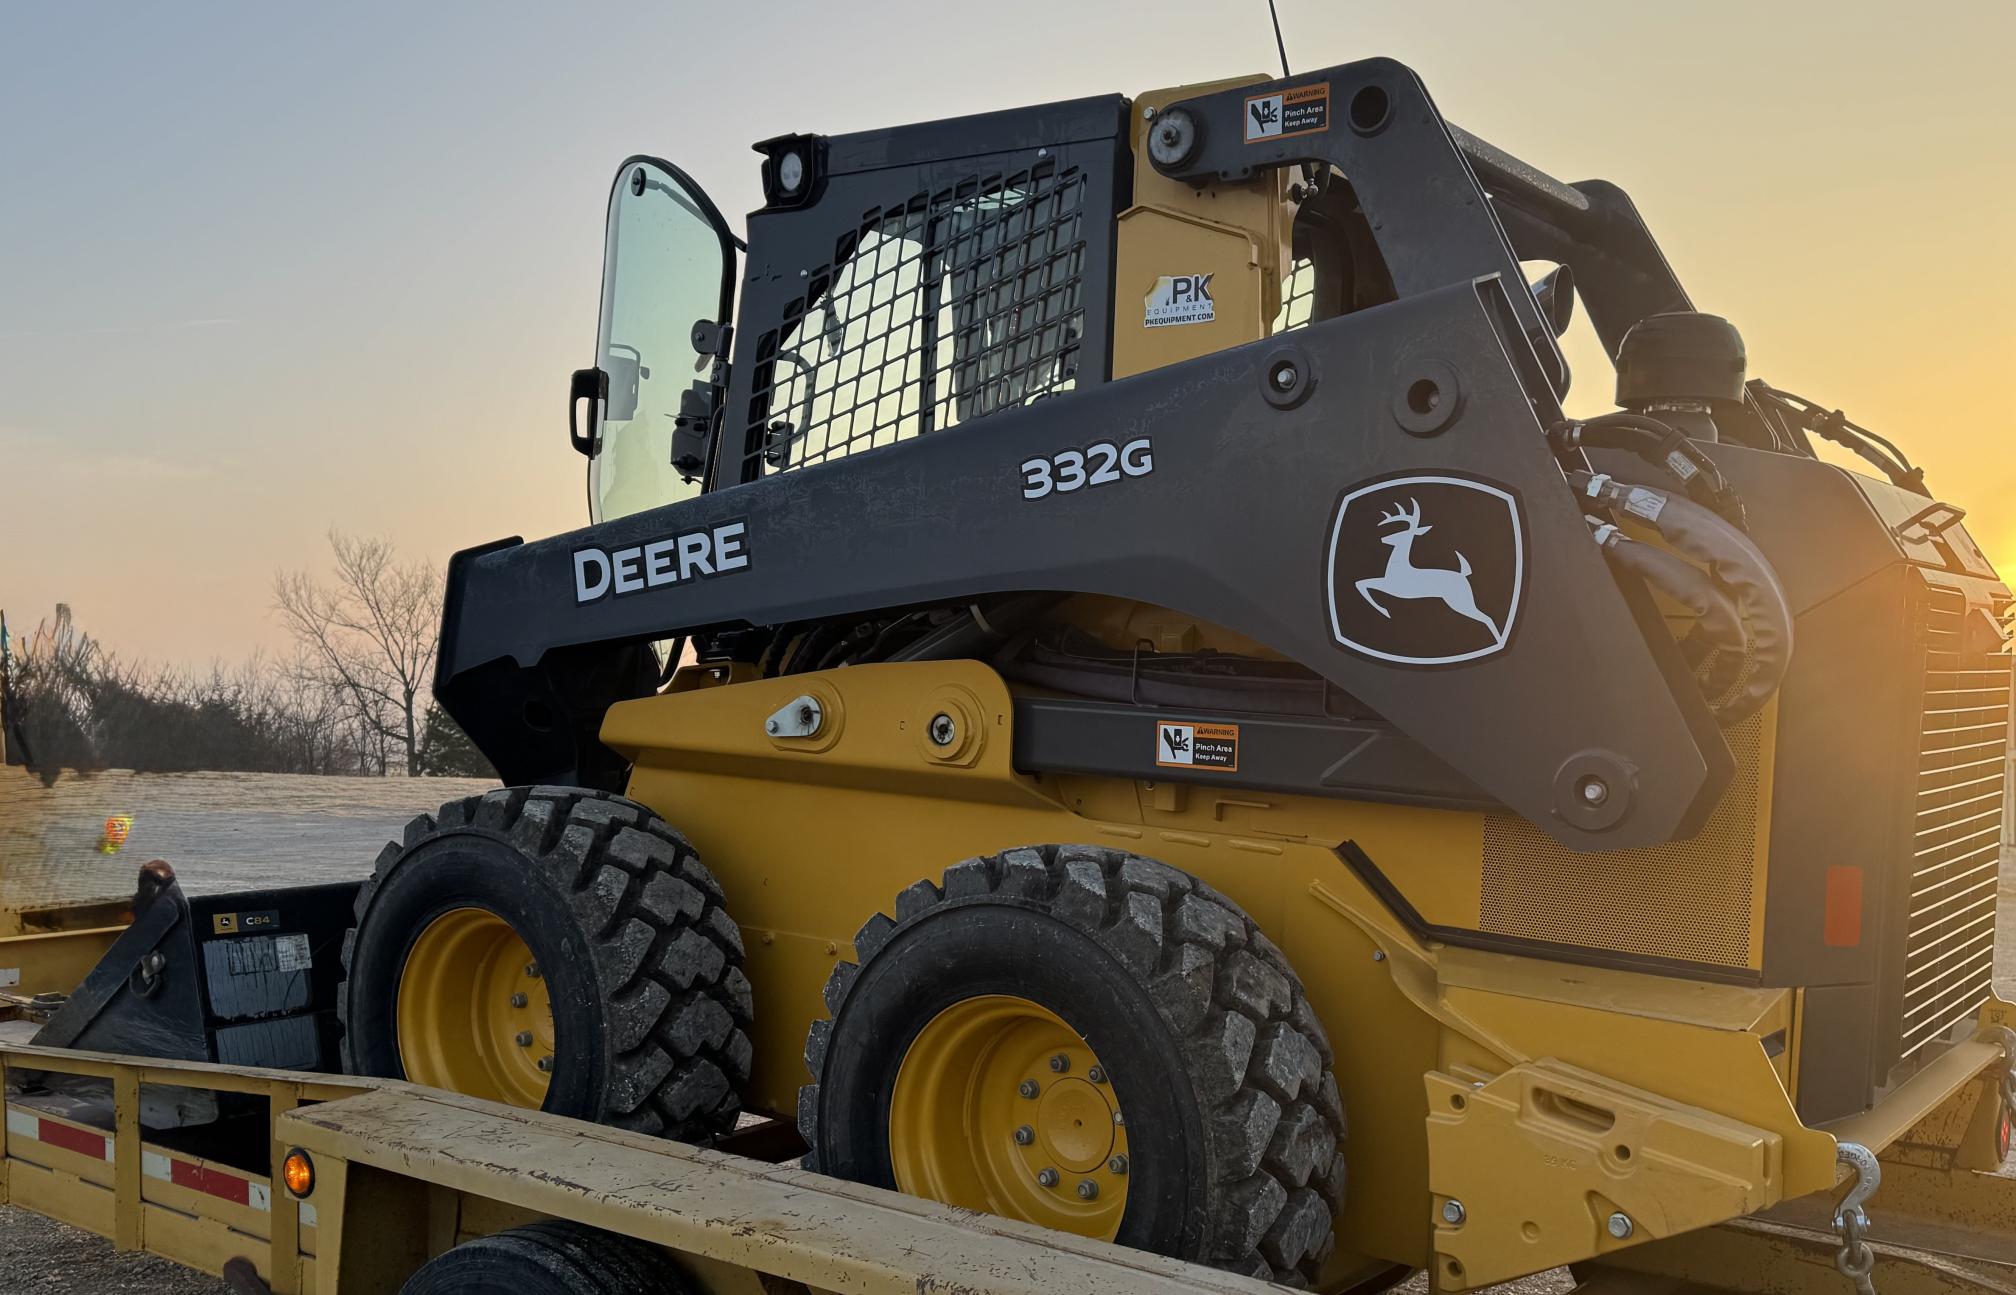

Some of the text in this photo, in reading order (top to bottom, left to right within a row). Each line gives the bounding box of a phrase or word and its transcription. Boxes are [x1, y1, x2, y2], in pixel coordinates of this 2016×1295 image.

[1292, 88, 1326, 99] WARNING
[1284, 106, 1324, 118] Pinch Area
[1284, 117, 1318, 128] Keep Away
[1147, 303, 1213, 316] EQUIPMENT
[1144, 312, 1214, 326] PKEQUIPMENT.COM
[1021, 439, 1153, 499] 332G
[573, 522, 748, 602] DEERE
[1195, 743, 1233, 753] Pinch Area
[1195, 752, 1228, 763] Keep Away
